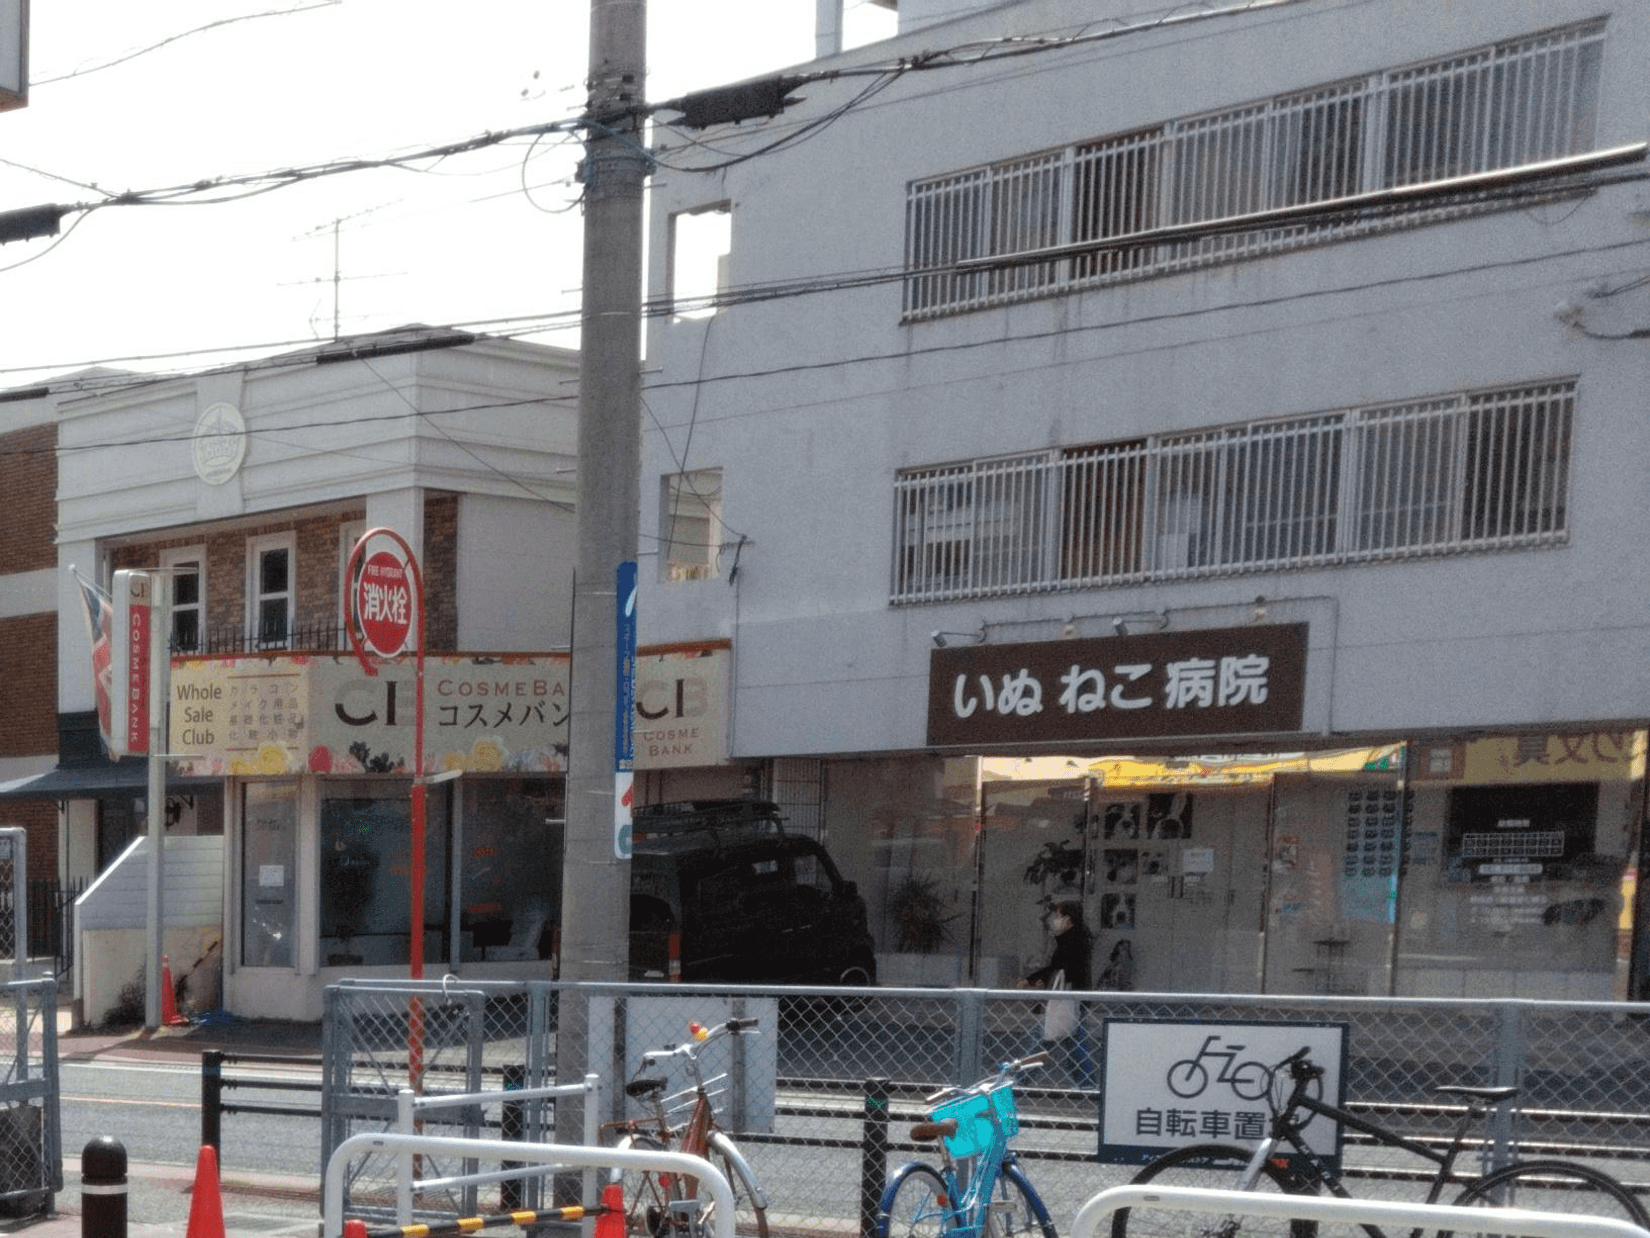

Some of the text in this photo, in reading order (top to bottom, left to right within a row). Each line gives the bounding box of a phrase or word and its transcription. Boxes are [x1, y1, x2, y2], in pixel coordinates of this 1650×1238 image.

[363, 581, 408, 625] 消火栓
[177, 683, 222, 700] Whole
[954, 653, 1270, 719] いぬ ねこ 病院
[184, 706, 214, 723] Sale
[438, 701, 570, 729] コスメバン
[182, 728, 215, 745] Club
[643, 728, 700, 742] COSME
[648, 743, 693, 757] BANK
[1136, 1107, 1299, 1140] 自転車置
